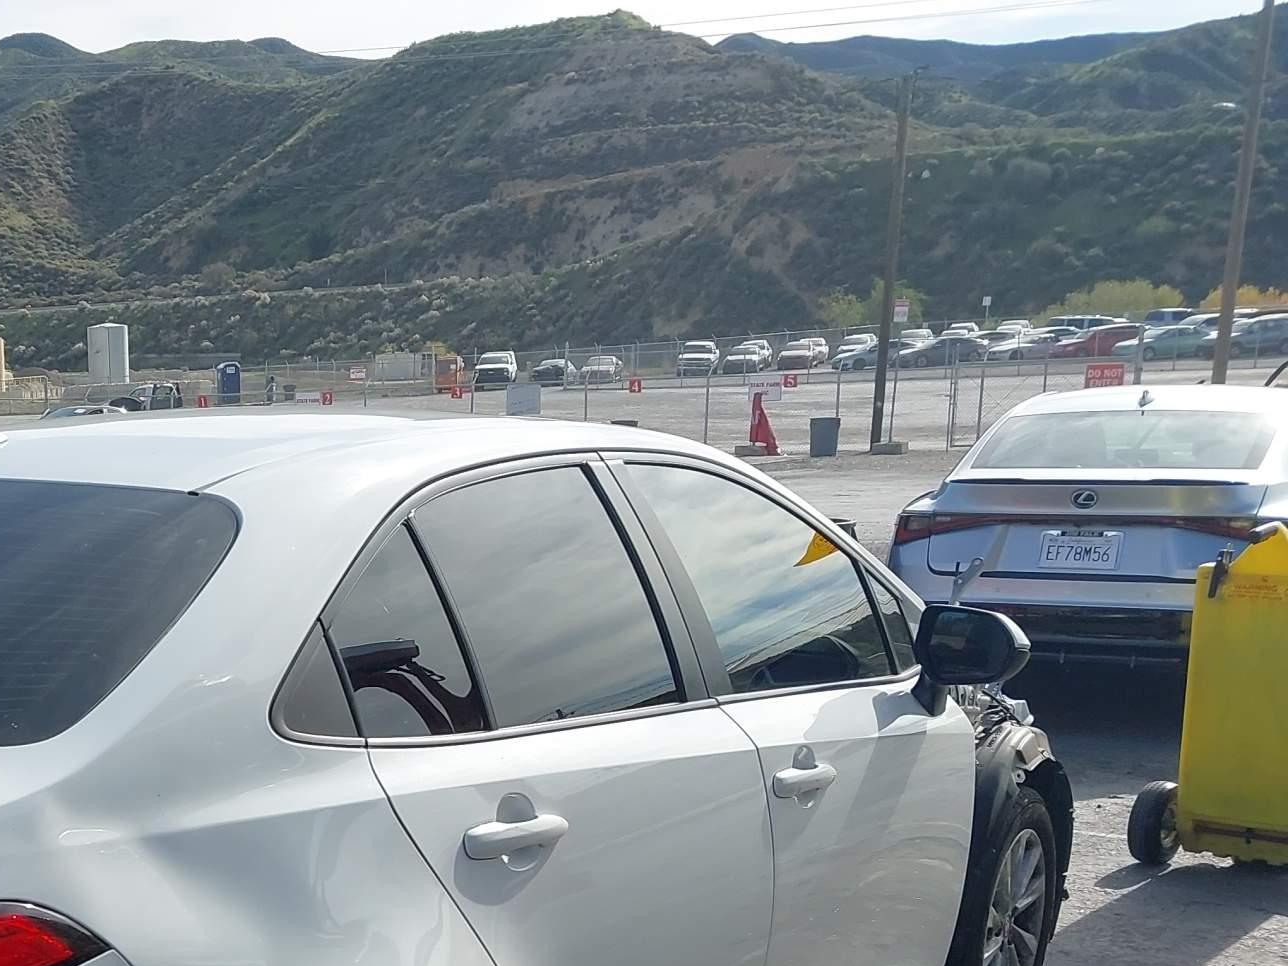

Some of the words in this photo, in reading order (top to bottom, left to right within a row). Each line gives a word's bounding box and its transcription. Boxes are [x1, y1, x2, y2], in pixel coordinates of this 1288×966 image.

[1087, 368, 1101, 378] DO
[1103, 368, 1122, 378] NOT
[1046, 544, 1111, 562] EF78M56
